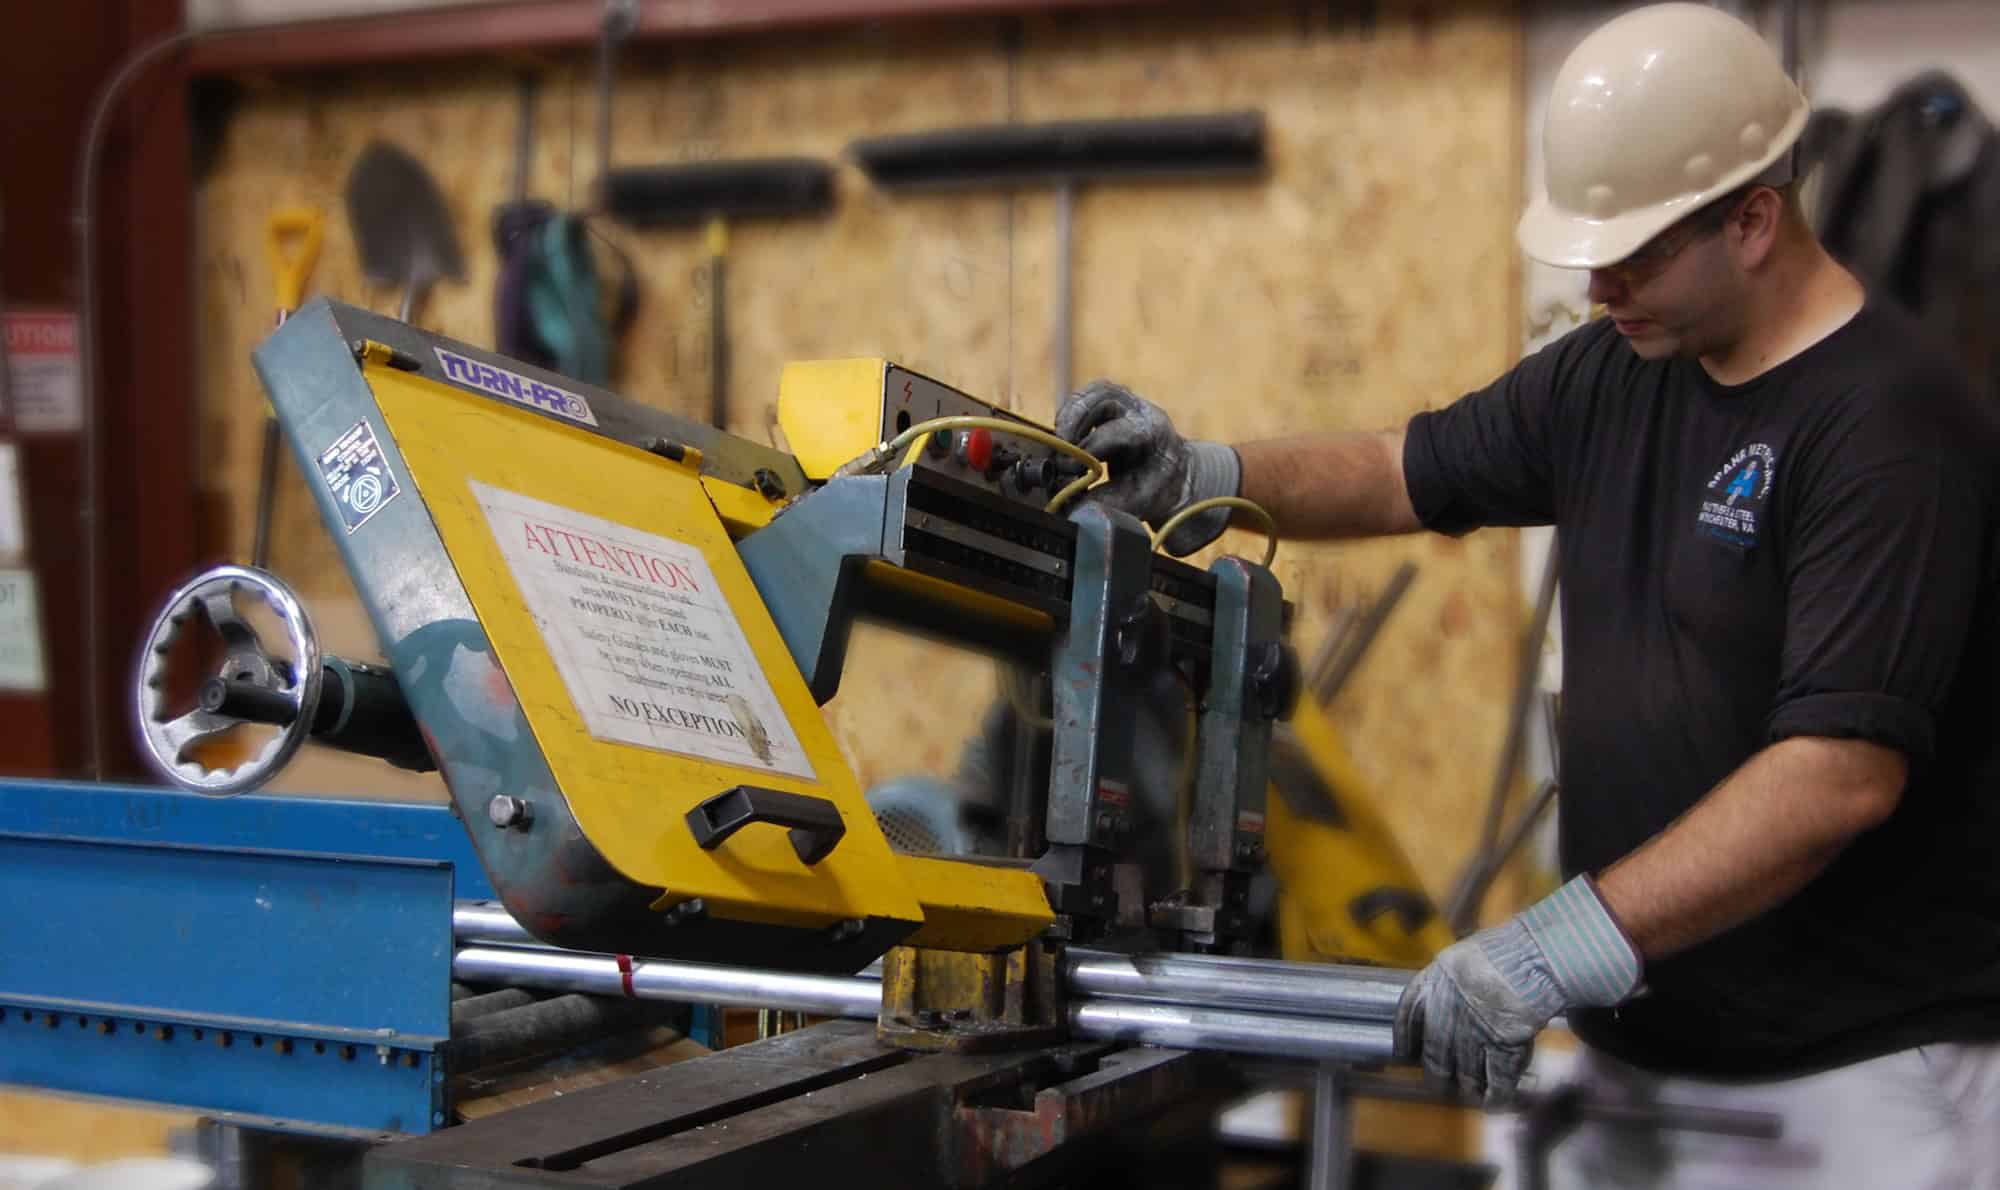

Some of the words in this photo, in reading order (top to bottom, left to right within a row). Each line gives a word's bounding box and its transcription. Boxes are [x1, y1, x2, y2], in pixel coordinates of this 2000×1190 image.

[442, 352, 588, 420] TURN-PRO
[523, 520, 701, 593] ATTENTION
[569, 596, 635, 622] PROPERLY
[658, 618, 694, 637] EACH
[601, 588, 637, 607] MUST
[577, 625, 611, 647] Safety
[698, 655, 733, 673] MUST
[711, 674, 735, 689] ALL
[608, 694, 640, 719] NO
